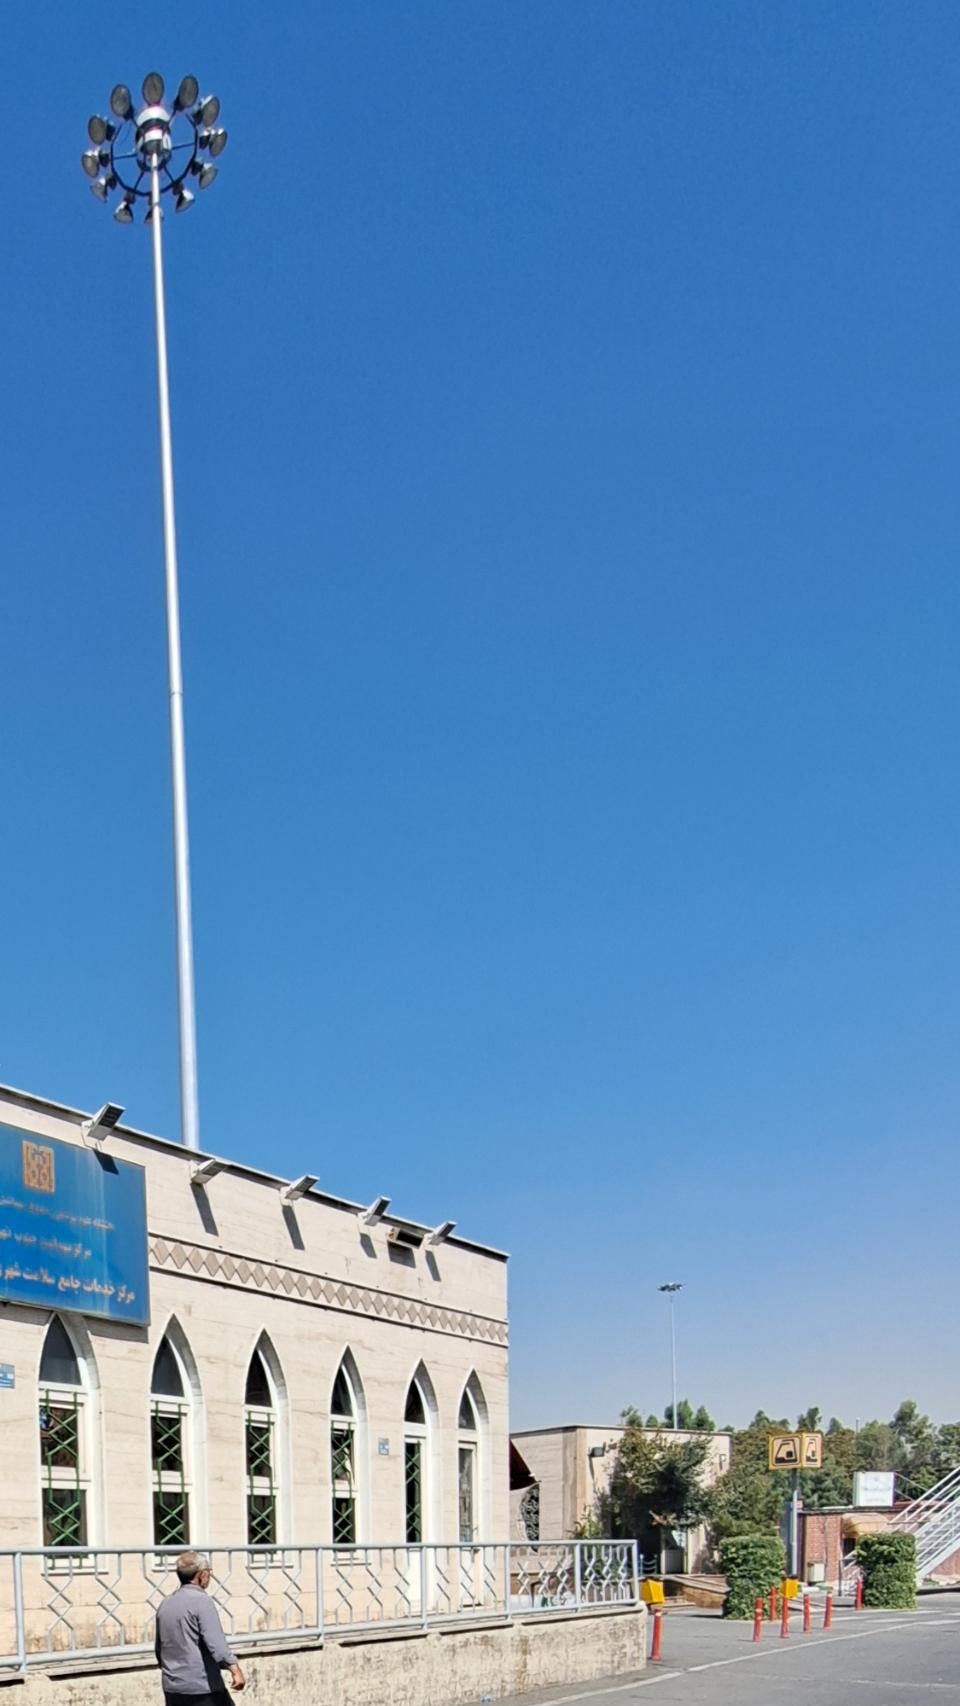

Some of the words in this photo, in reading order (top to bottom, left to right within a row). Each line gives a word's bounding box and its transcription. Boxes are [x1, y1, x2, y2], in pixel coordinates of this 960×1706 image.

[22, 1267, 56, 1284] سلامت
[58, 1273, 81, 1294] جامع
[82, 1277, 115, 1295] خدمات
[116, 1282, 135, 1304] مرکز
